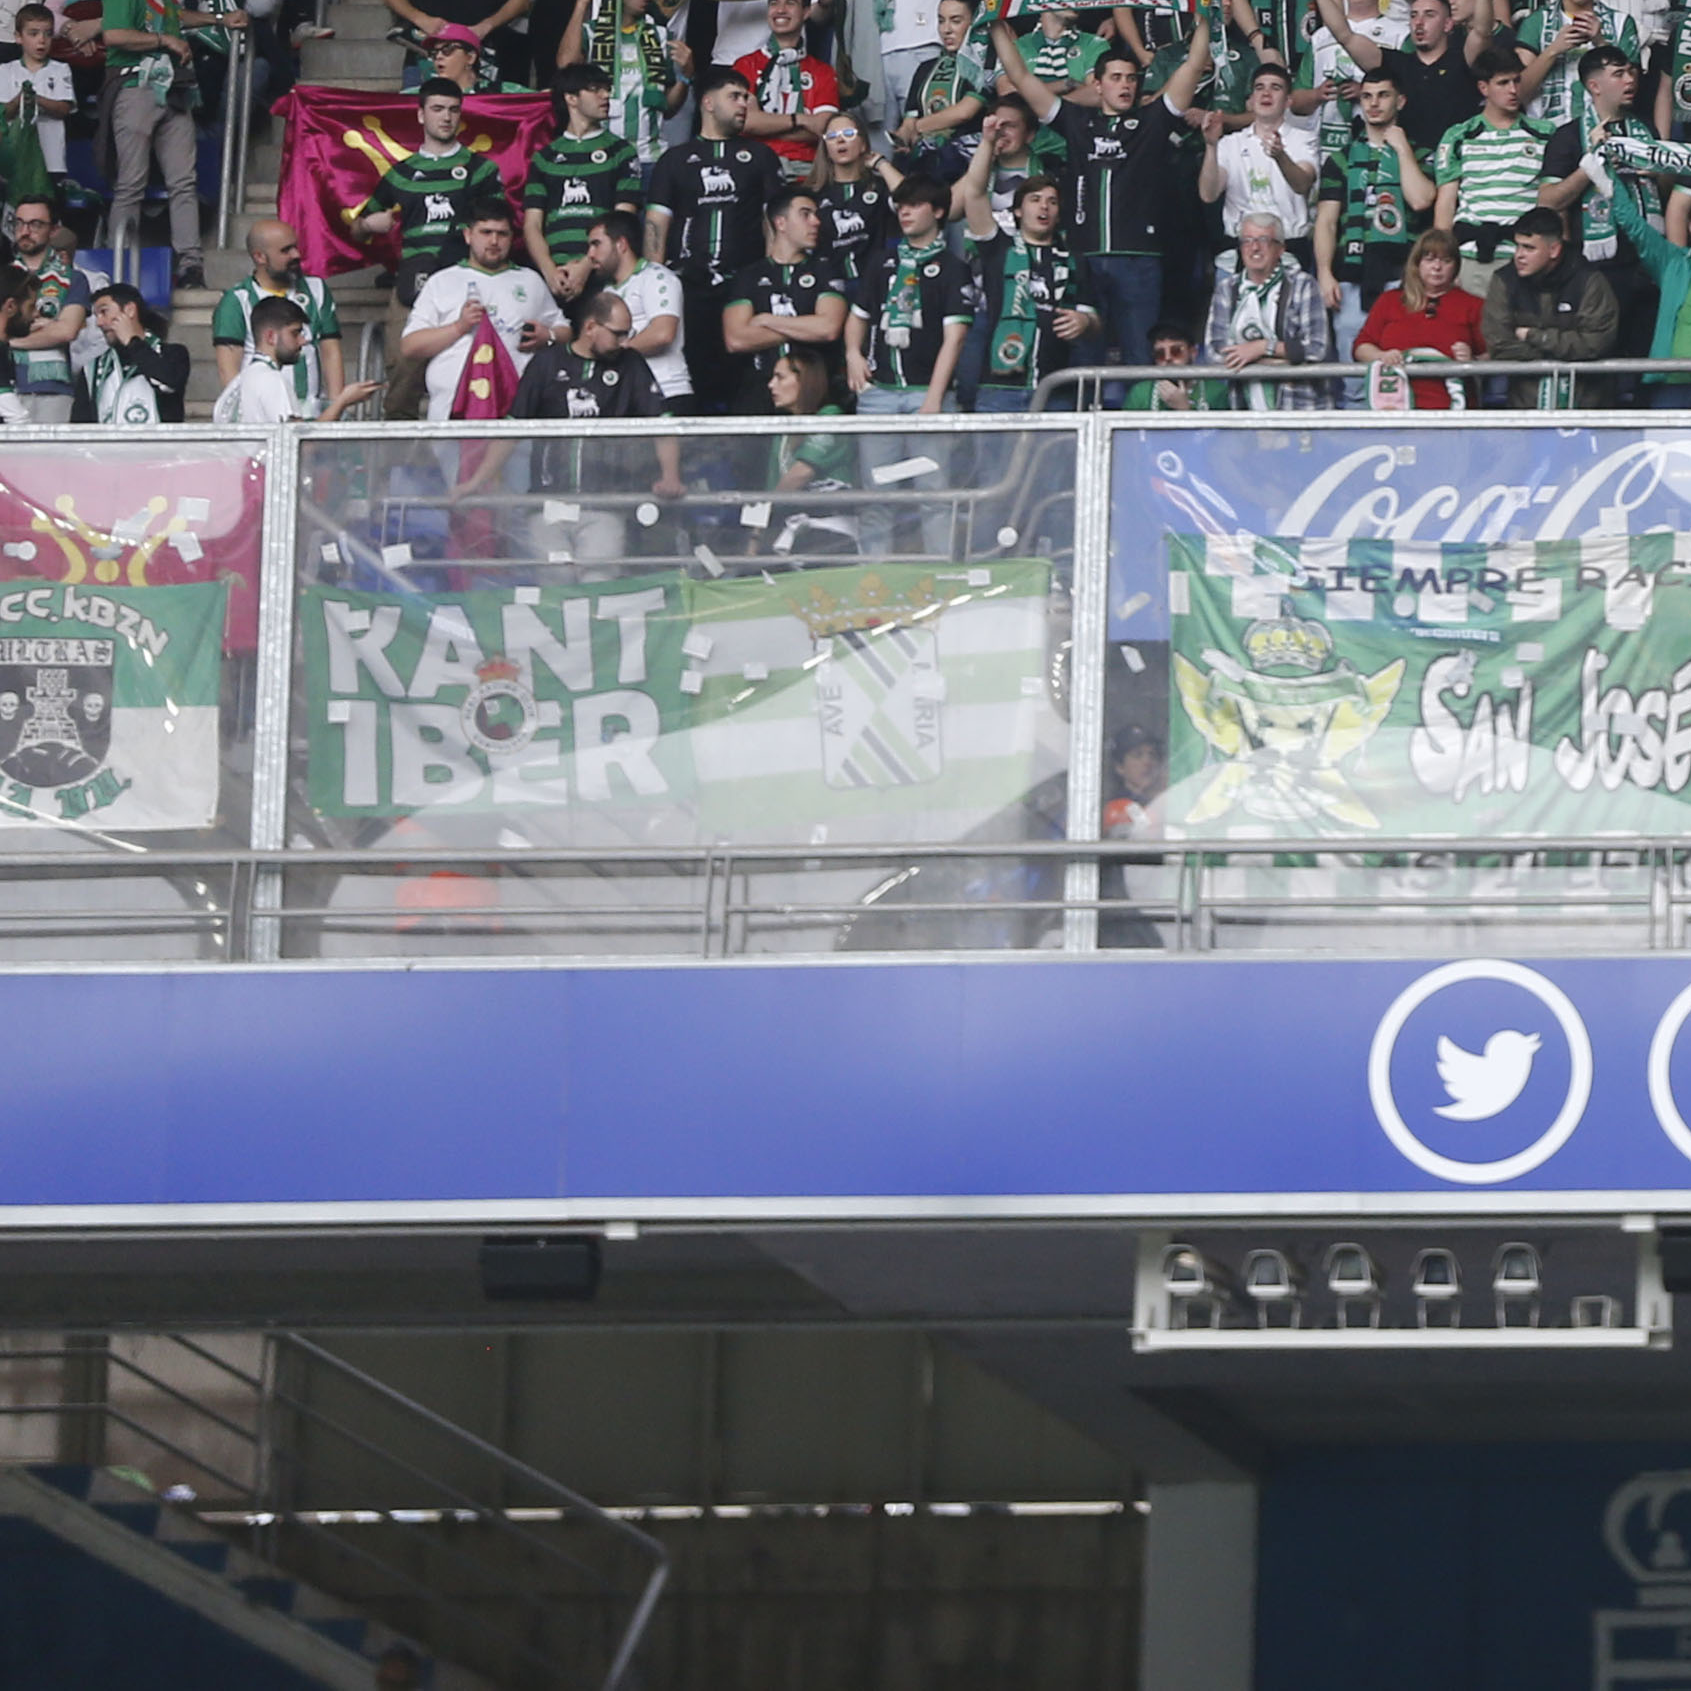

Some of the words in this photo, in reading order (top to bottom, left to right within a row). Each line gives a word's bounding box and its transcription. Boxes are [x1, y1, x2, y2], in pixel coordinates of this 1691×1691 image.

[1074, 0, 1126, 8] SANTANDER
[1297, 565, 1548, 594] SIEMPRE
[322, 586, 668, 698] KANT
[327, 688, 669, 808] IBER
[1409, 651, 1534, 805] SAN
